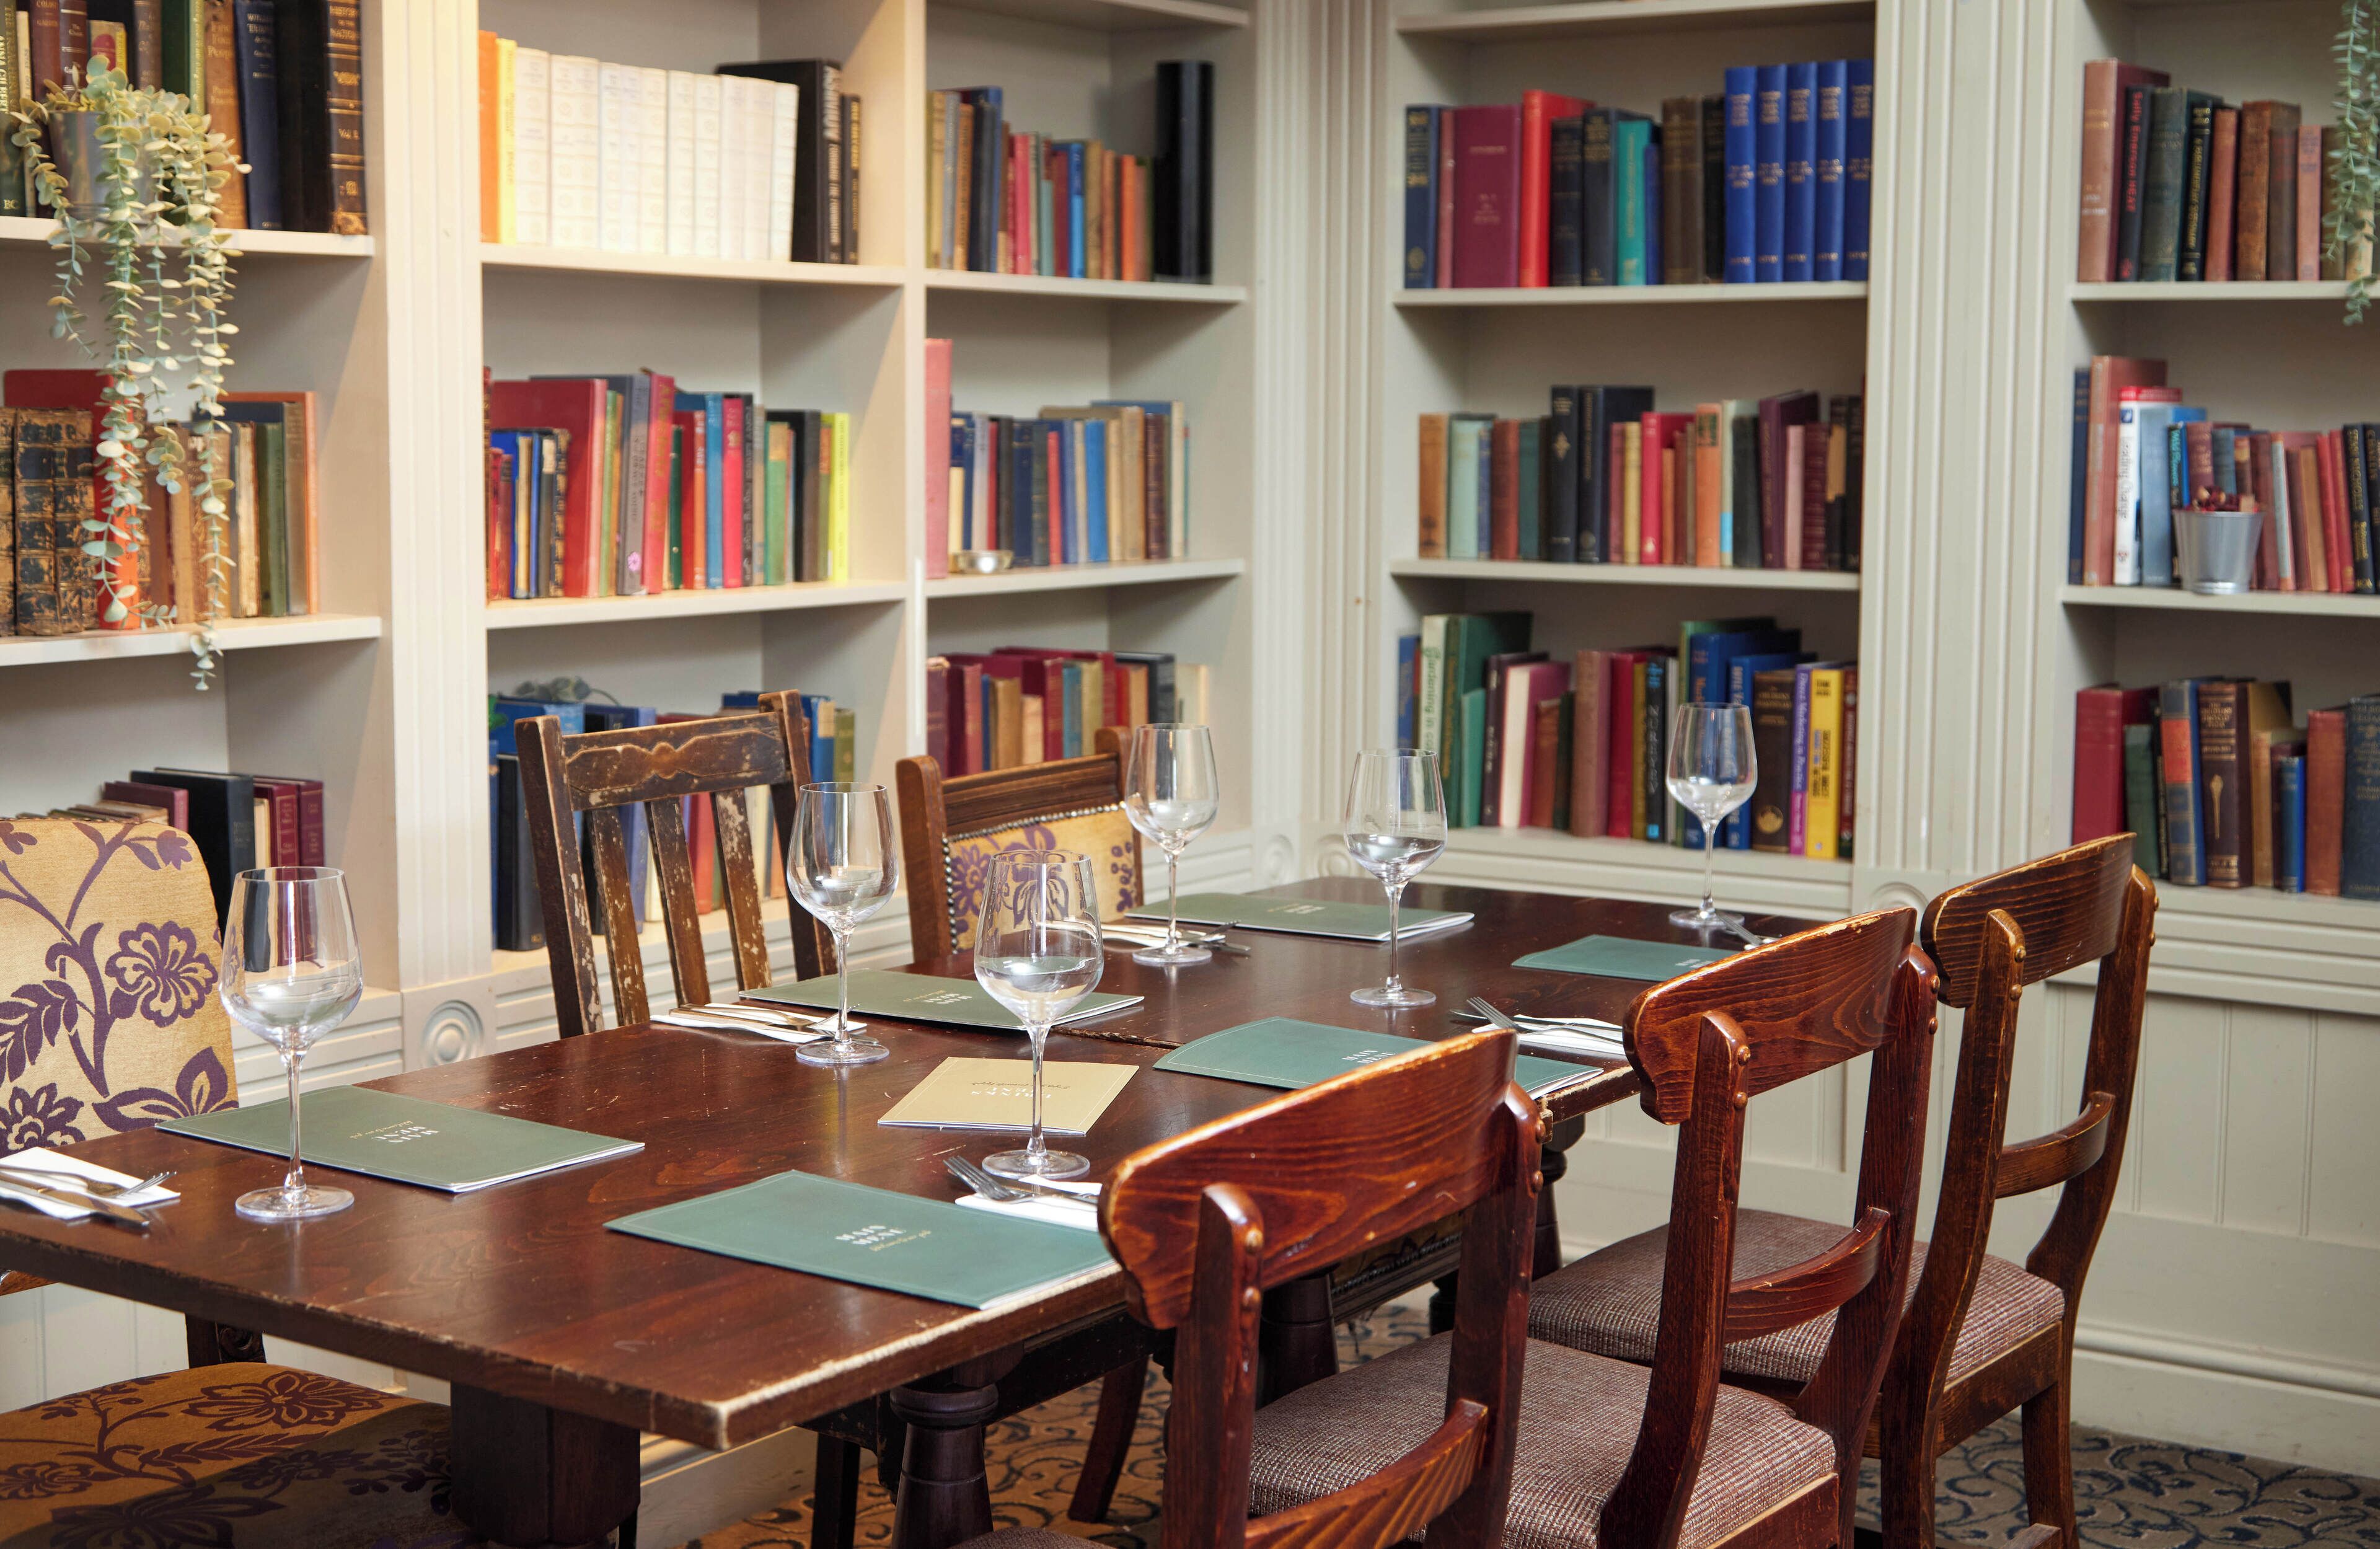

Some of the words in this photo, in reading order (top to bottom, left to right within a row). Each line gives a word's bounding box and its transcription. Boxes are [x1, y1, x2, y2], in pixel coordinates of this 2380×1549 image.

[1341, 1050, 1378, 1061] MAIN
[1357, 1051, 1396, 1063] MENU
[371, 1126, 427, 1141] MENU
[387, 1130, 439, 1143] MAIN
[835, 1224, 886, 1240] MAIN
[852, 1228, 907, 1245] MENU
